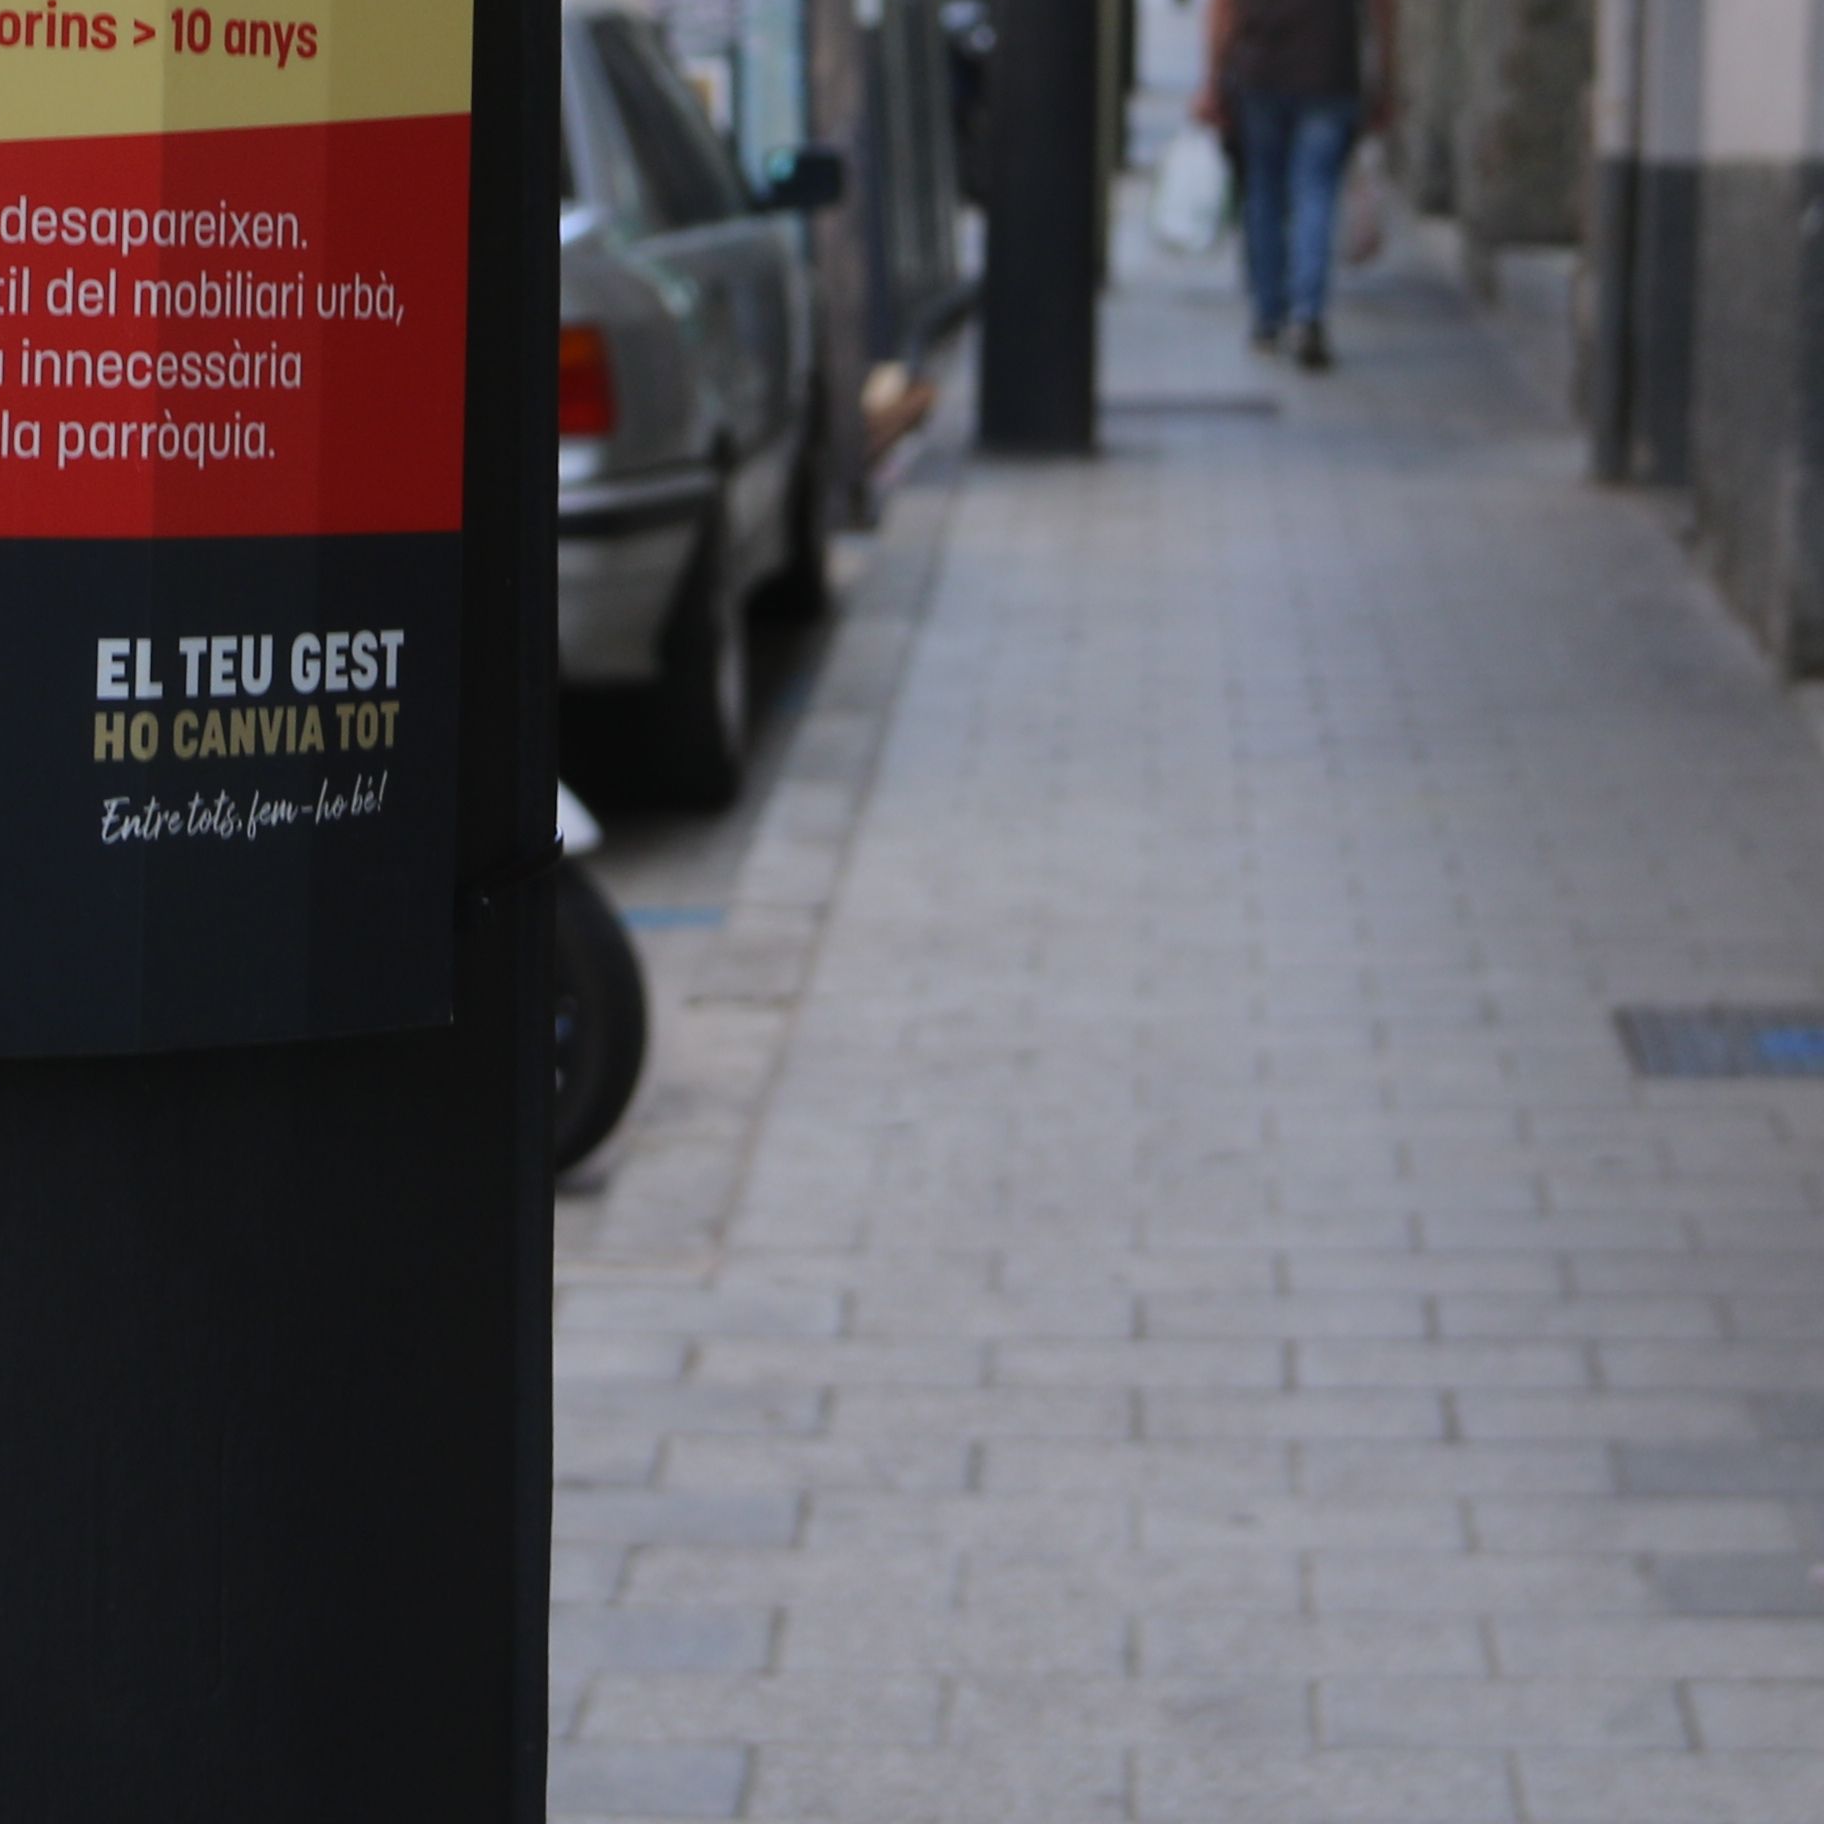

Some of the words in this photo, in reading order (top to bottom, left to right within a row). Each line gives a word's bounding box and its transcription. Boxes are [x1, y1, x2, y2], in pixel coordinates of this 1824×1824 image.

[170, 7, 212, 55] 10
[223, 17, 319, 70] anys
[0, 195, 309, 257] desapareixen.
[45, 267, 117, 317] del
[133, 271, 305, 320] mobiliari
[315, 272, 406, 327] urbà,
[21, 338, 304, 391] innecessària
[0, 409, 41, 461] la
[57, 409, 276, 470] parròquia.
[95, 636, 164, 701] EL
[178, 634, 274, 699] TEU
[290, 628, 405, 696] GEST
[92, 710, 160, 763] HO
[173, 703, 325, 761] CANVIA
[335, 700, 401, 752] TOT
[100, 794, 184, 846] Entre
[185, 788, 243, 841] tots,
